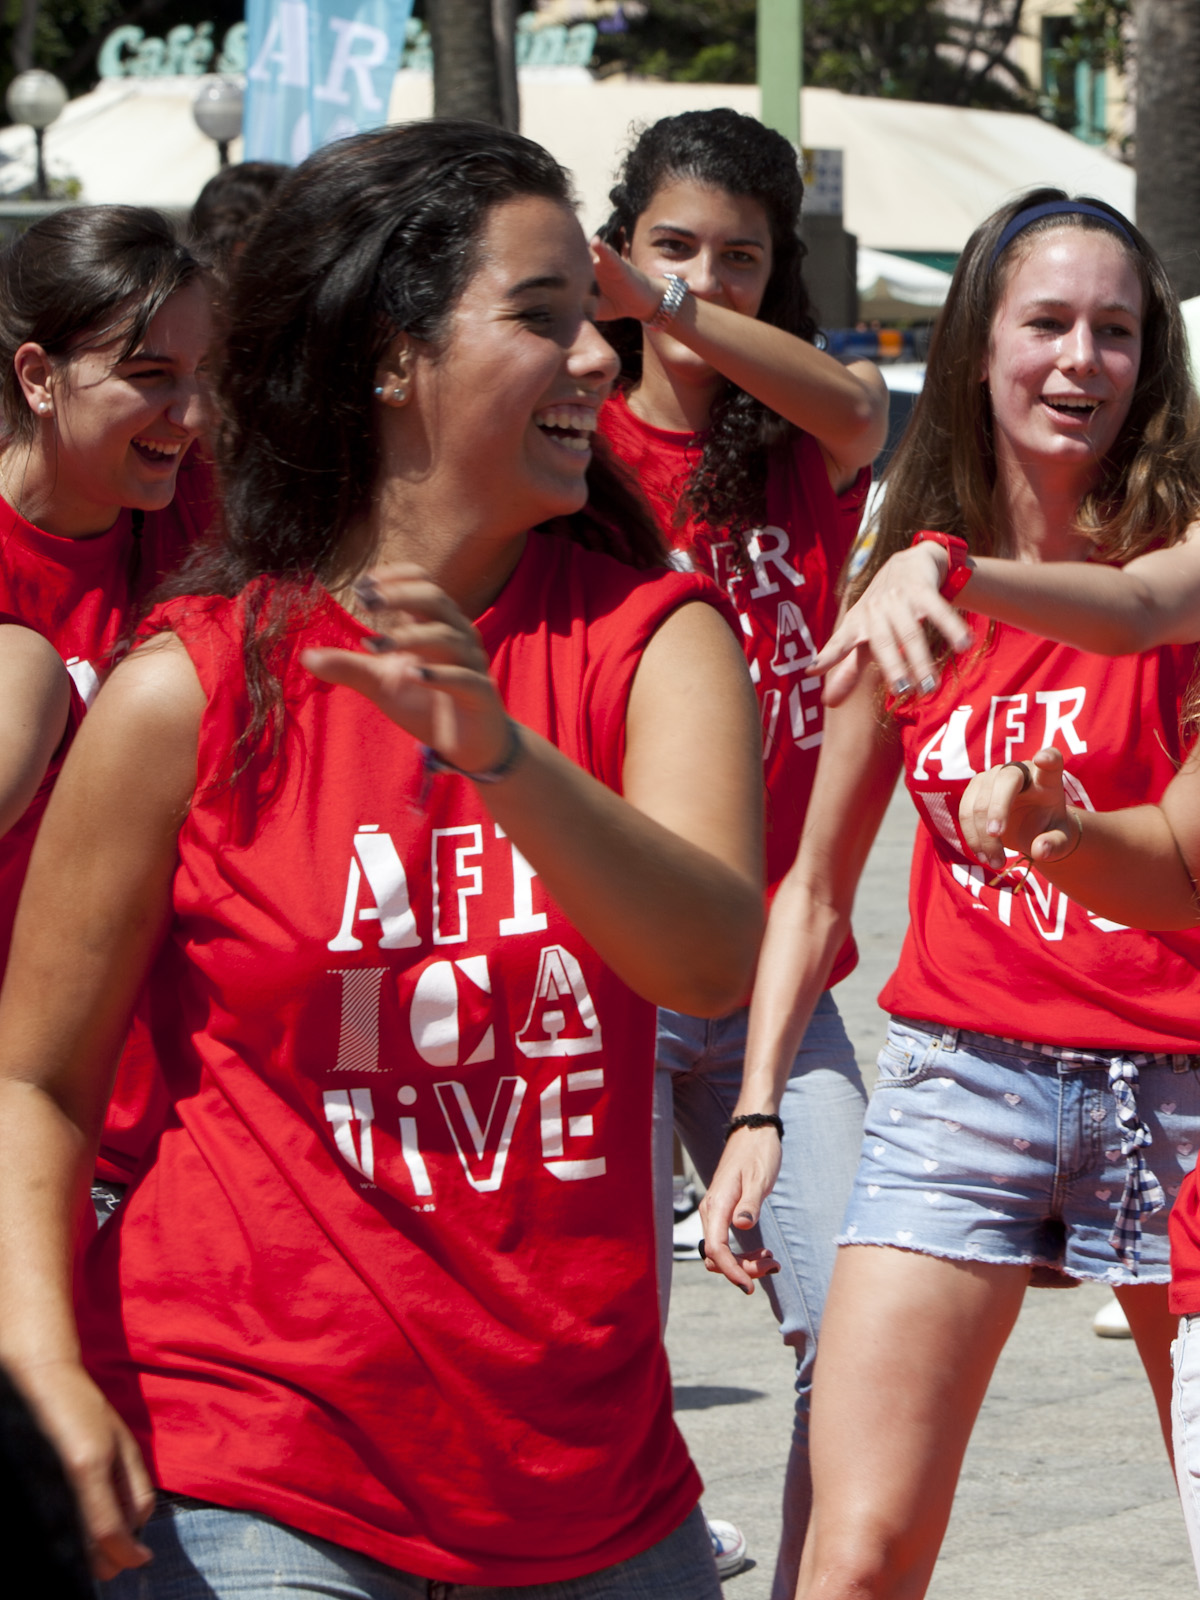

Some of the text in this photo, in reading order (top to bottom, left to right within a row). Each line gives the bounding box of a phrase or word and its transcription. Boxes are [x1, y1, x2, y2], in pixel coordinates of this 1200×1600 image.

[97, 20, 214, 78] Café
[913, 686, 1088, 781] AFR
[326, 944, 603, 1073] ICA
